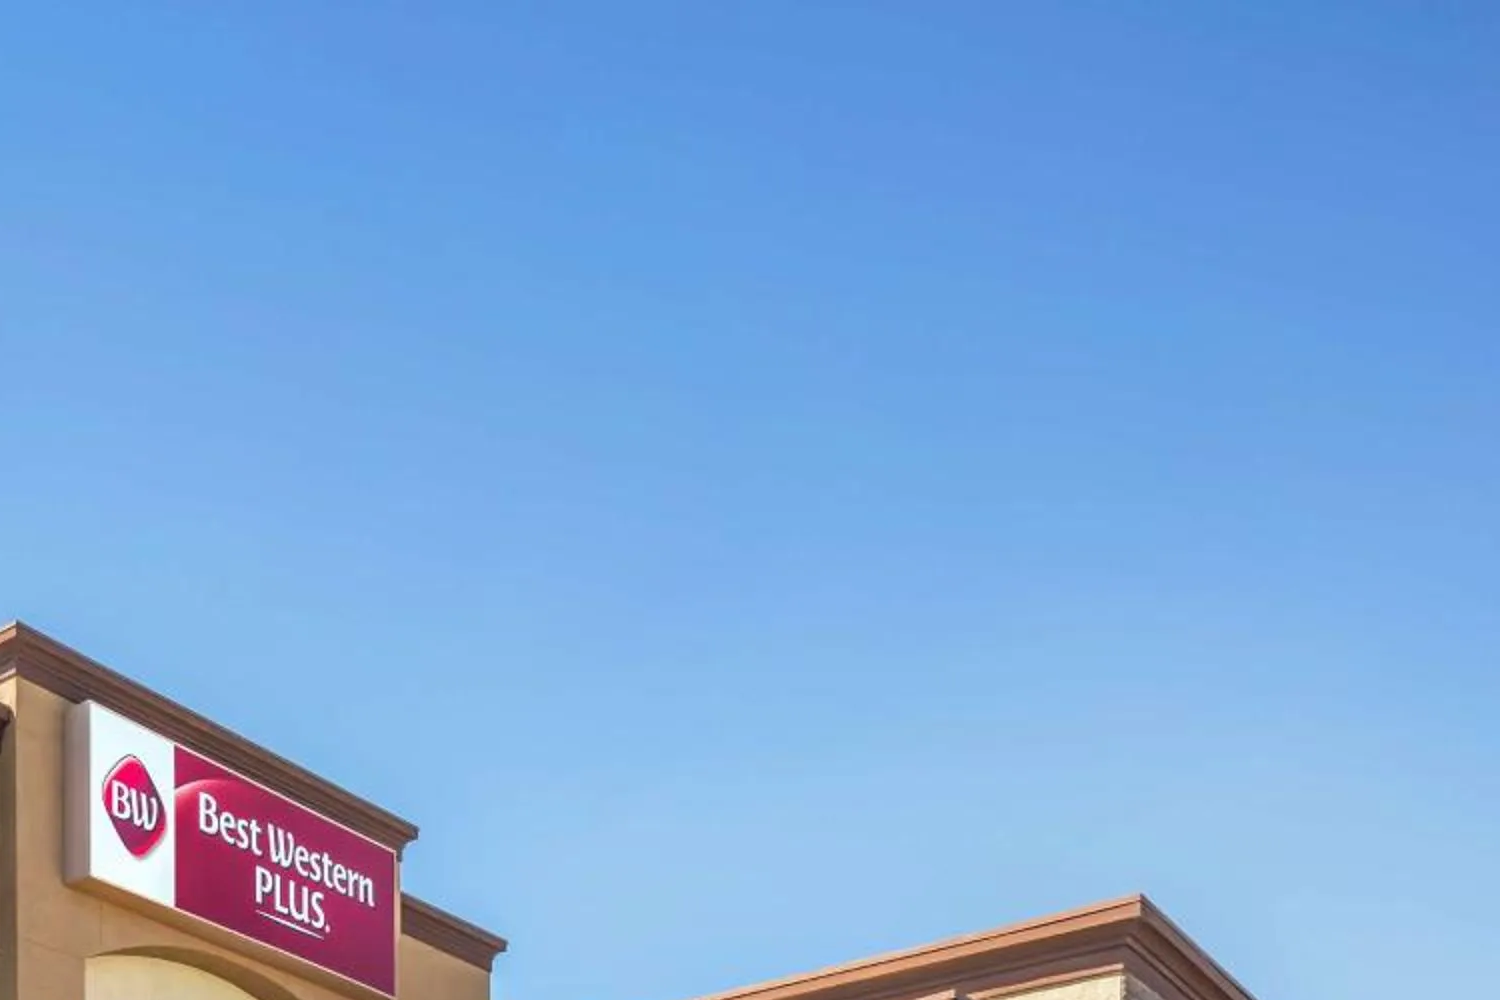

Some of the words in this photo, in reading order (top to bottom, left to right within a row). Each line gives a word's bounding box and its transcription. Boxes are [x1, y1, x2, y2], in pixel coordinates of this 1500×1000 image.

[111, 779, 158, 832] BW
[198, 791, 262, 856] Best
[268, 822, 375, 908] Western
